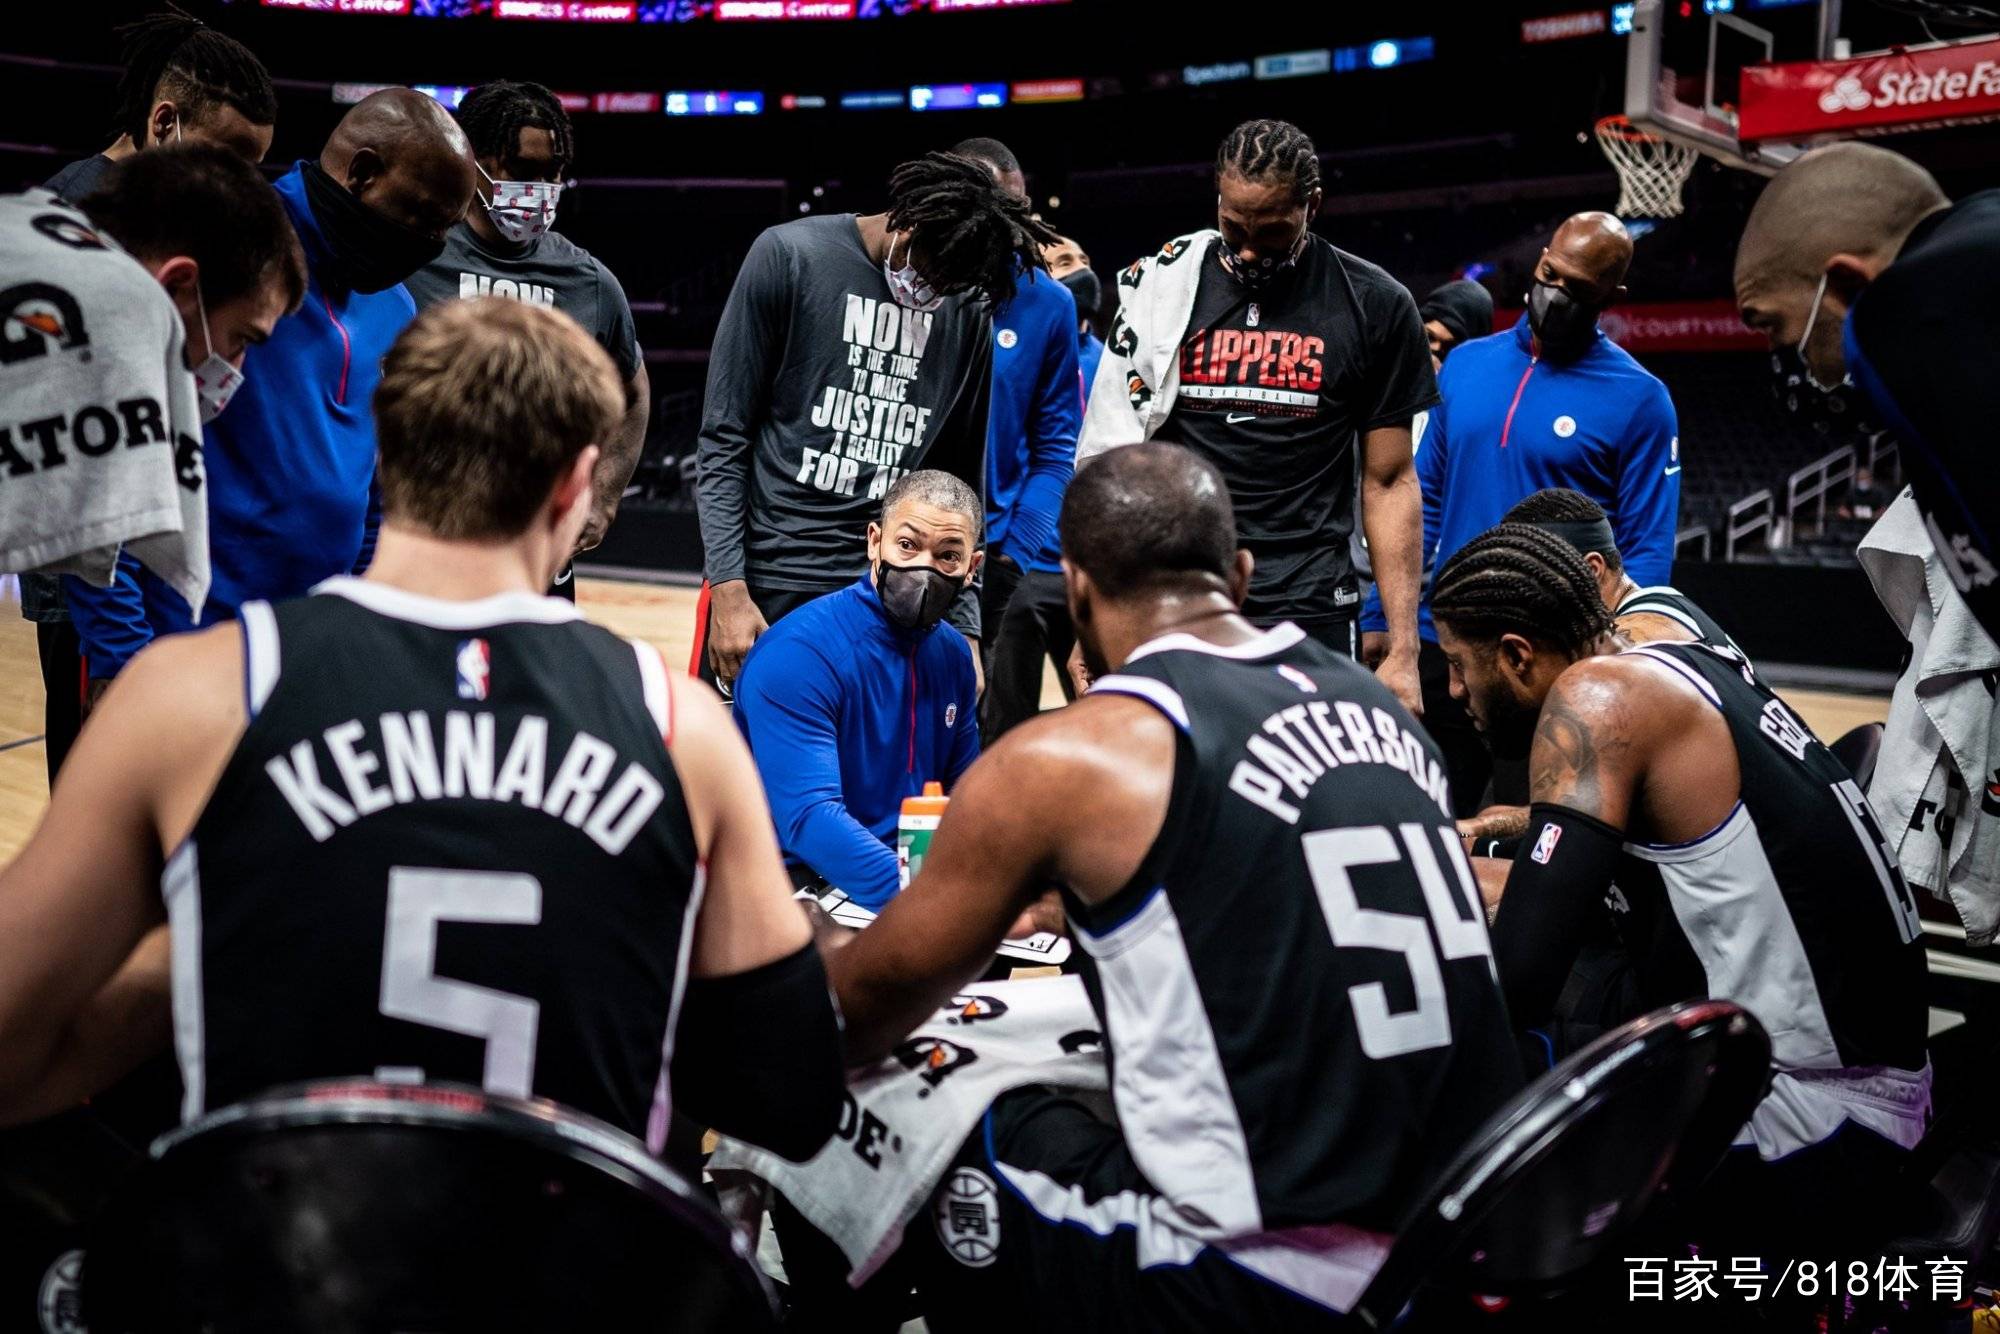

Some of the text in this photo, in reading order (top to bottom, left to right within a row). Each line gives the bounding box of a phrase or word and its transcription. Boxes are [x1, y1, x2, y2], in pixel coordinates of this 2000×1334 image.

[843, 294, 933, 358] NOW
[848, 344, 920, 380] IS THE TIME
[852, 368, 909, 402] TO MAKE
[811, 386, 932, 447] JUSTICE
[796, 447, 859, 496] FOR
[830, 432, 905, 465] A REALITY
[264, 710, 665, 856] KENNARD
[1228, 700, 1452, 825] PATTERSON
[1301, 823, 1498, 1060] 54
[374, 866, 542, 1099] 5
